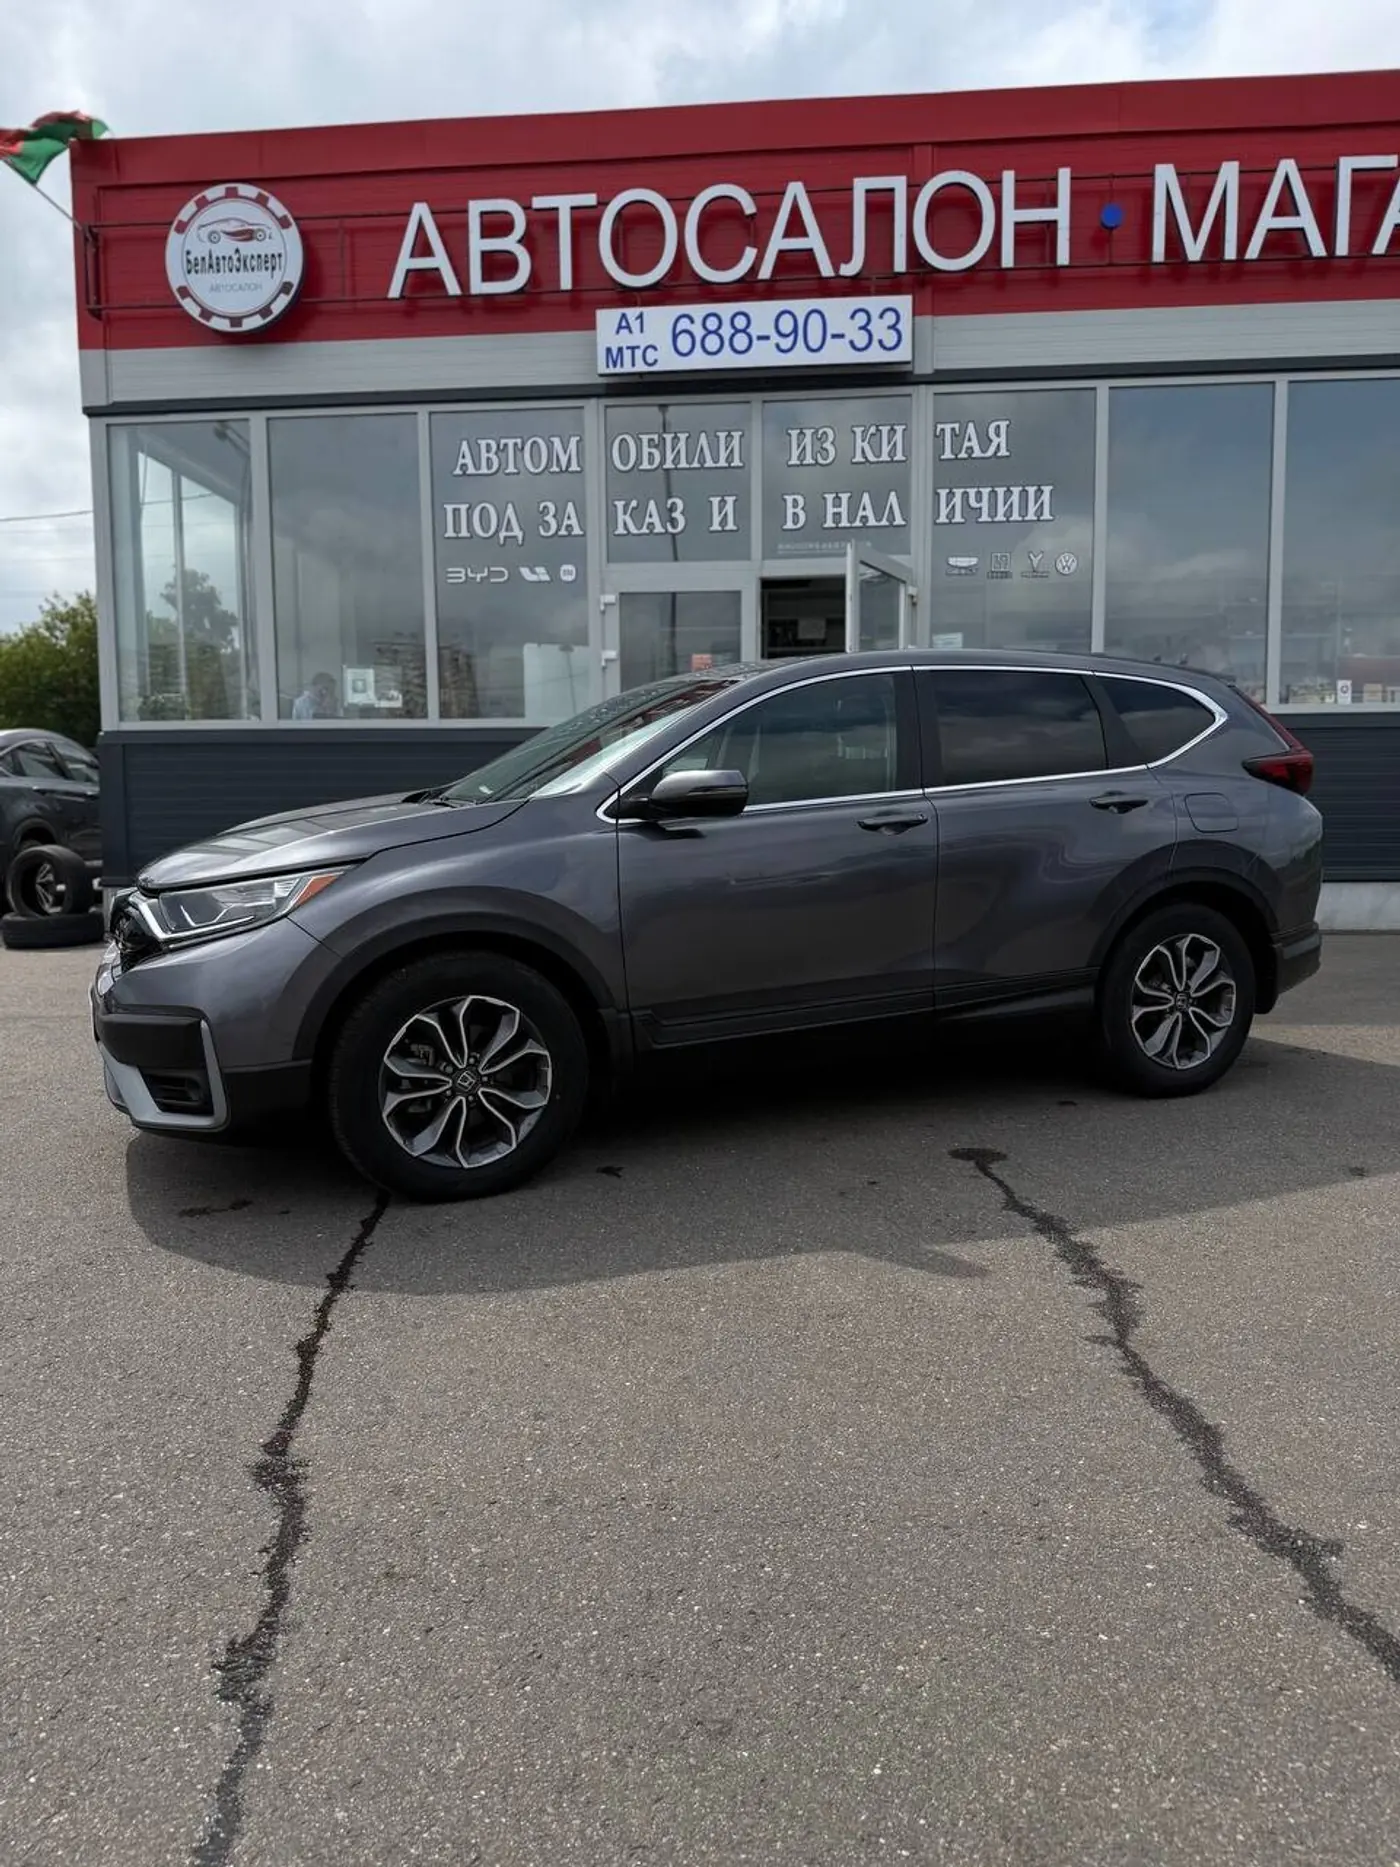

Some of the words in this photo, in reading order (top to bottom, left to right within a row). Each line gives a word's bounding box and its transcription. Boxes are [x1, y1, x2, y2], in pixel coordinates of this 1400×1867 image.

[387, 167, 1071, 299] АВТОСАЛОН
[186, 248, 282, 280] БелАвтоЭксперт
[615, 311, 645, 335] A1
[671, 307, 903, 357] 688-90-33
[605, 344, 659, 368] МТС
[786, 427, 836, 466] ИЗ
[443, 502, 524, 545] ПОД
[708, 496, 738, 531] И
[782, 494, 807, 530] В
